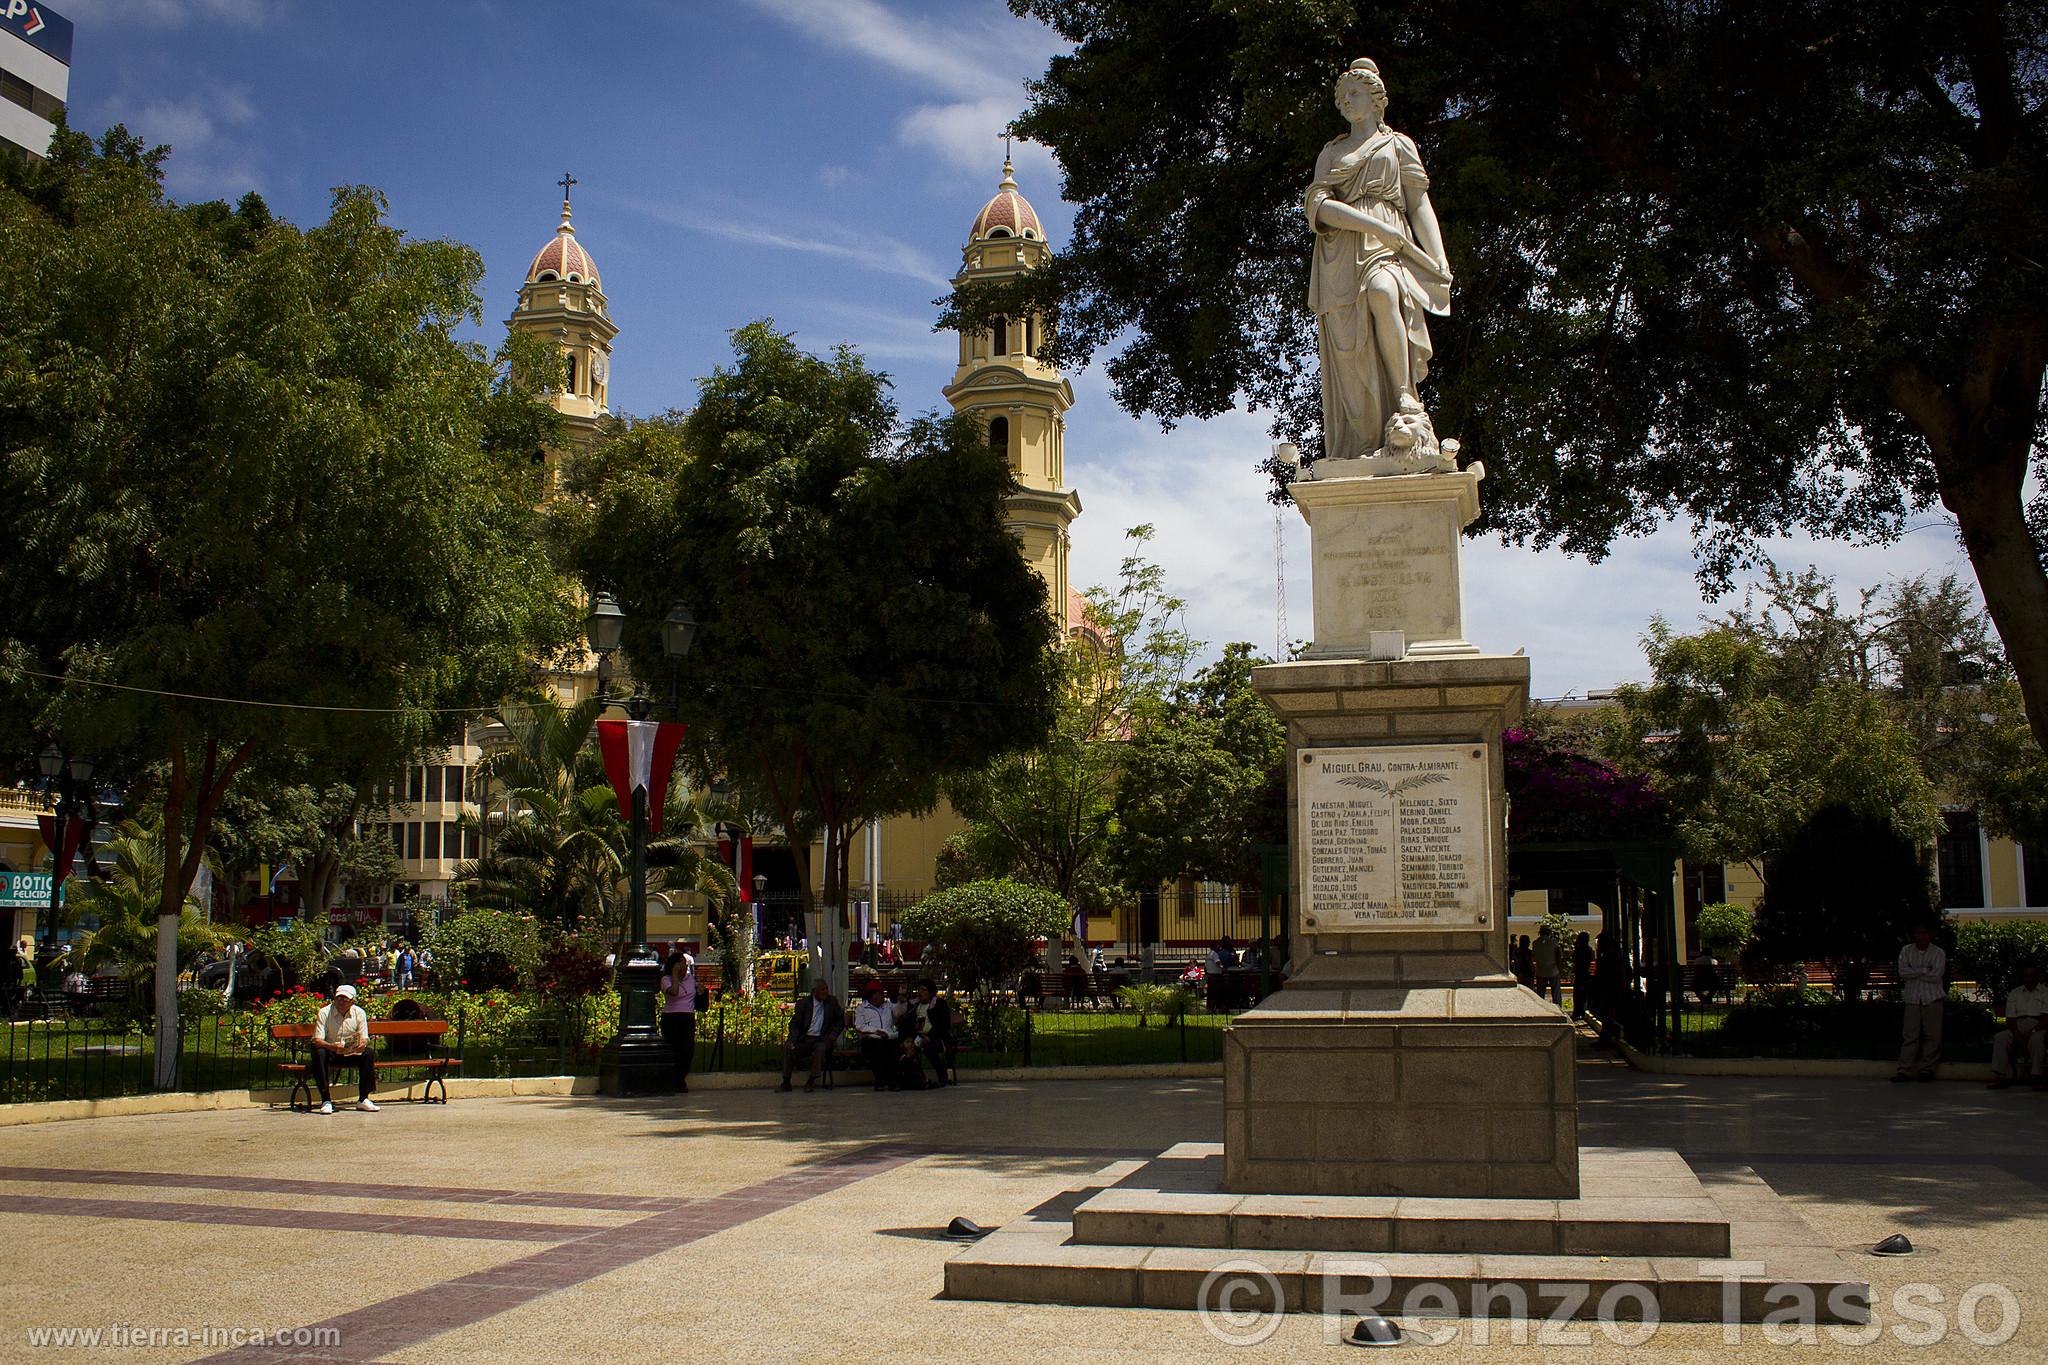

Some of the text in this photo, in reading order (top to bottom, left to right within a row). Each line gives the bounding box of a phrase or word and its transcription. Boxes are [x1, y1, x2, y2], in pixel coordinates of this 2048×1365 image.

[1322, 763, 1356, 774] MIGUEL
[1349, 800, 1373, 808] MIGUEL
[1438, 798, 1457, 806] SIXTO
[1370, 809, 1391, 817] FELIPE
[1400, 808, 1428, 816] MERINO,
[1311, 820, 1320, 828] DE
[1352, 819, 1373, 827] EMILIO
[1311, 829, 1333, 837] GARCIA
[1351, 828, 1379, 836] TEODORO
[1423, 835, 1448, 843] ENRIQUE
[1312, 847, 1342, 855] GONZALES
[1312, 856, 1346, 864] GUERRERO,
[1401, 854, 1437, 862] SEMINARIO,
[1312, 865, 1348, 873] GUTIERREZ,
[1401, 863, 1463, 871] SEMINARIO, TORIBIO
[1439, 872, 1465, 880] ALBERTO
[13, 875, 53, 890] BOTIC
[1312, 884, 1341, 892] HIDALGO,
[1313, 893, 1340, 901] MEDINA,
[1354, 911, 1370, 919] VERA
